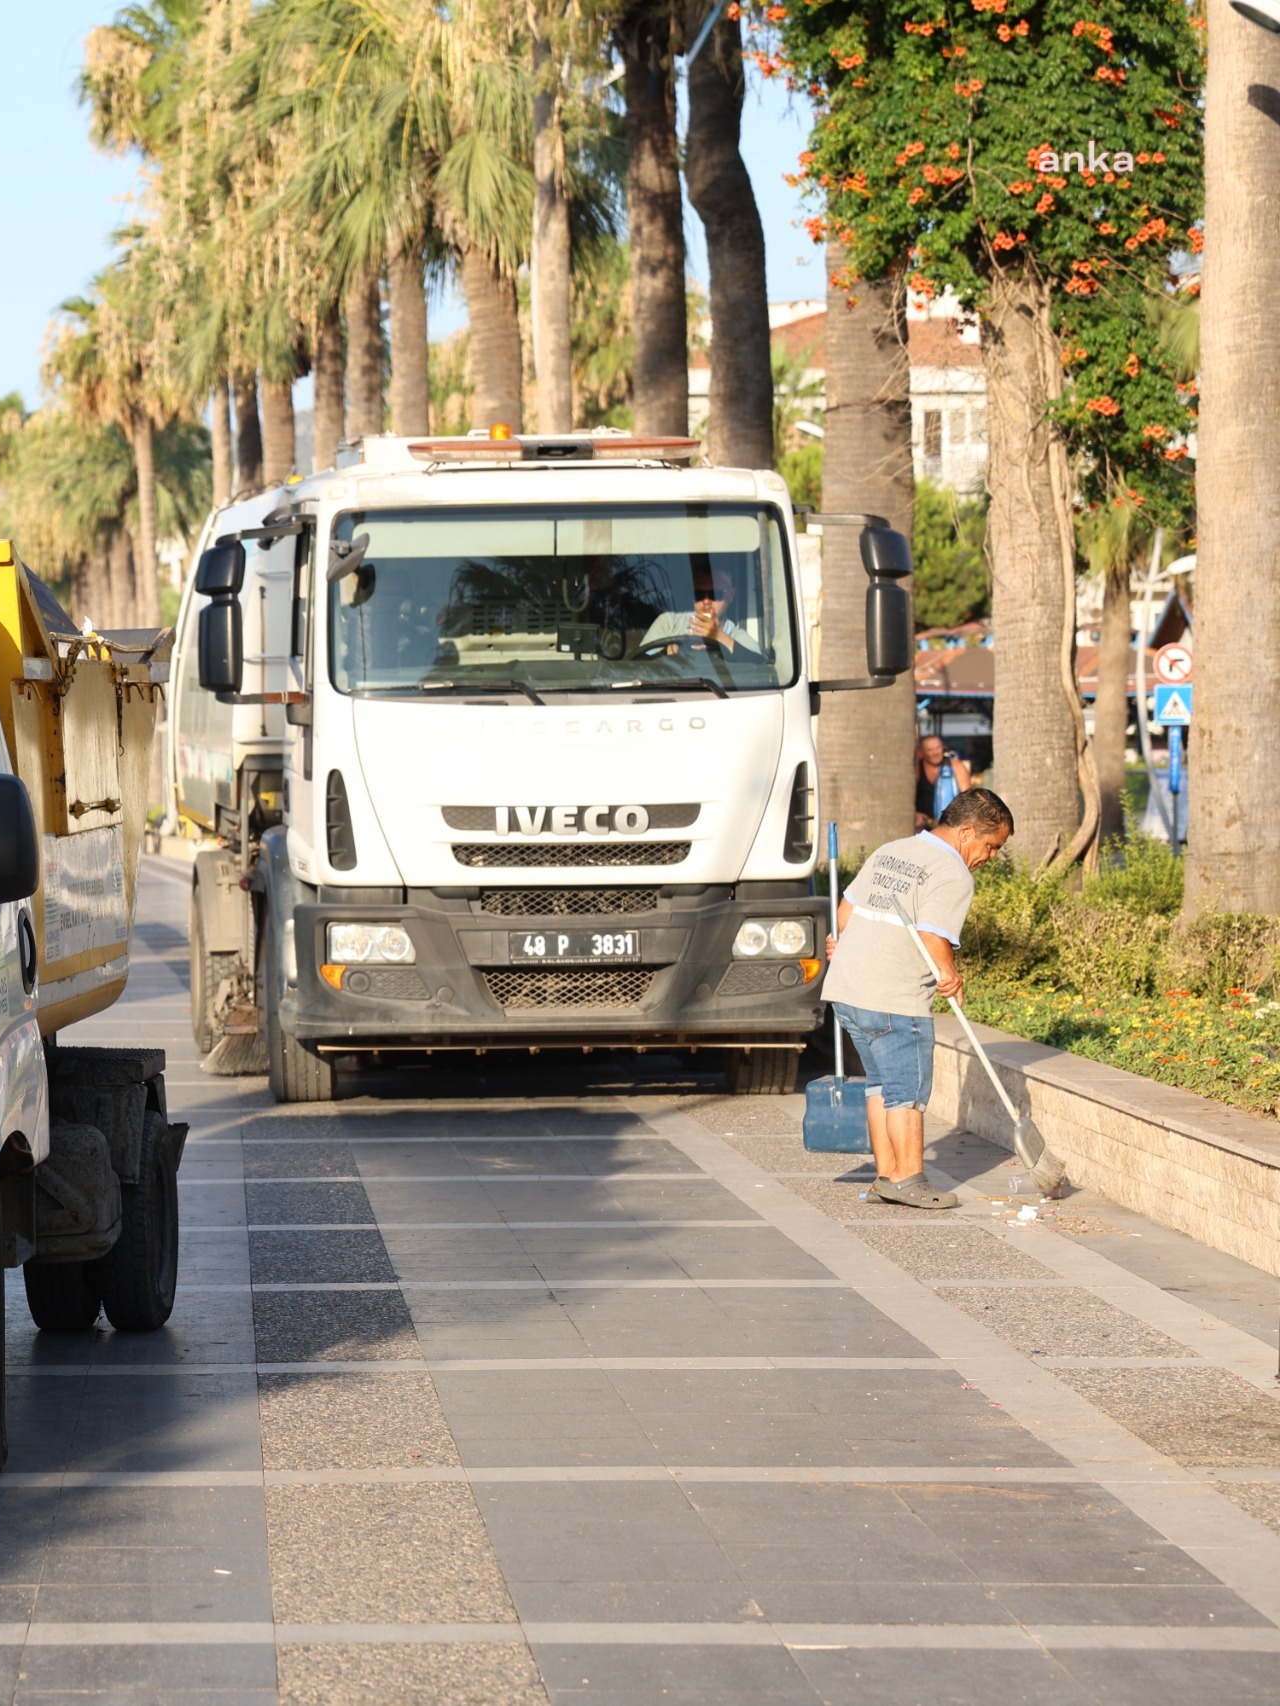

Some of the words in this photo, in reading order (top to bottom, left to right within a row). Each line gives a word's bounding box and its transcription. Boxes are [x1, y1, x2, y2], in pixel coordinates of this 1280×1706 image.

[494, 805, 650, 836] IVECO
[524, 935, 546, 956] 48
[558, 935, 569, 956] P
[591, 934, 633, 955] 3831
